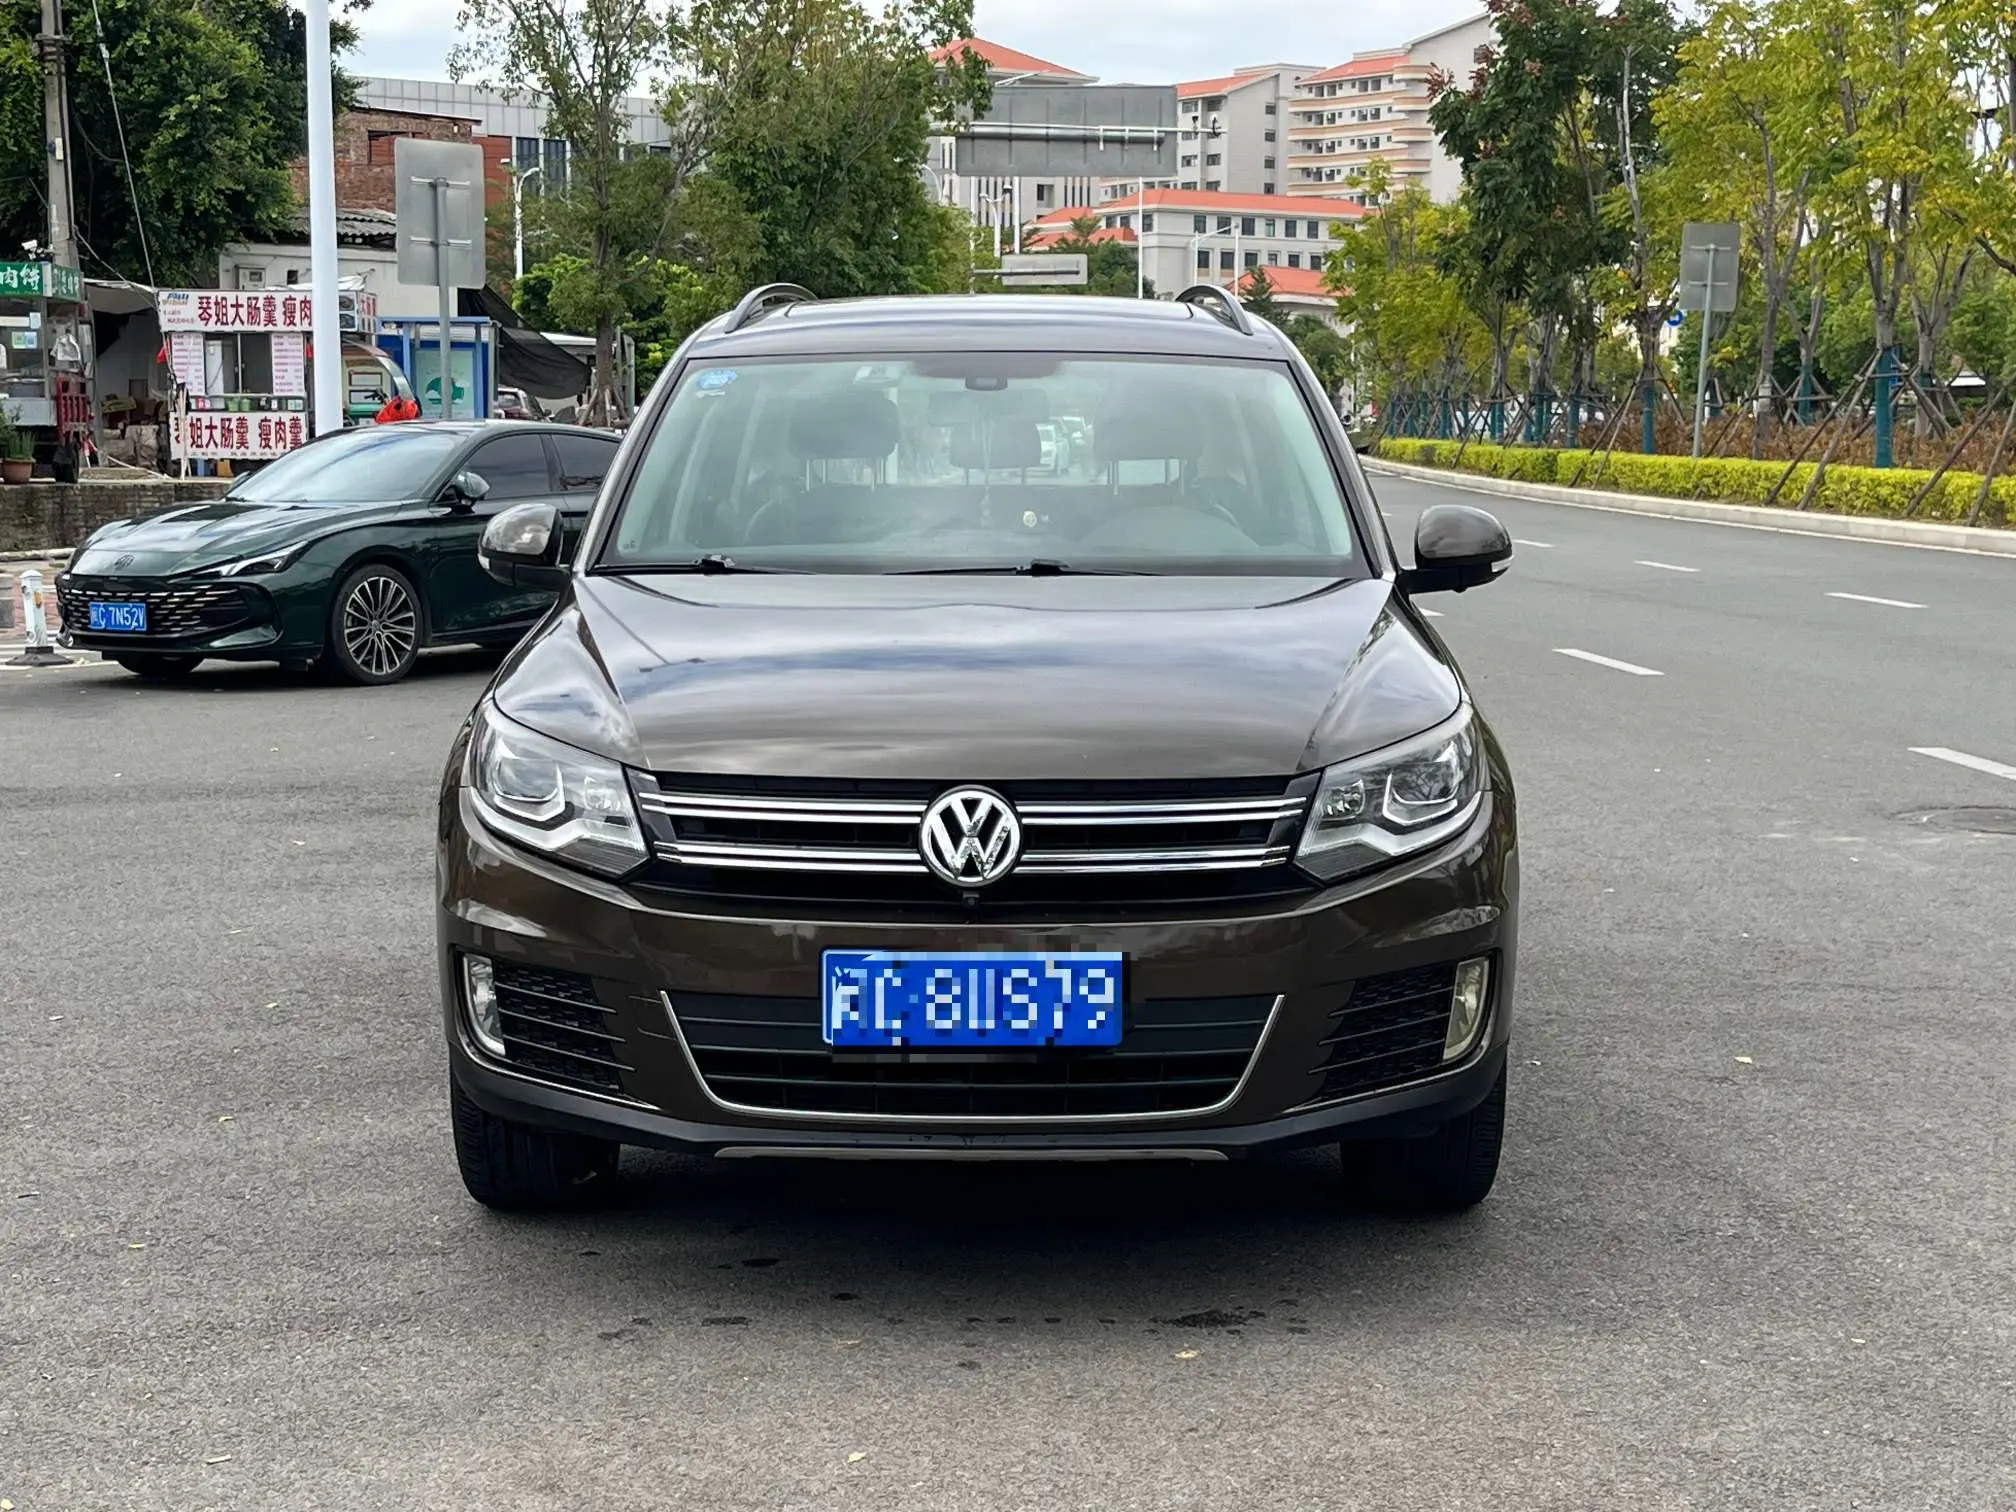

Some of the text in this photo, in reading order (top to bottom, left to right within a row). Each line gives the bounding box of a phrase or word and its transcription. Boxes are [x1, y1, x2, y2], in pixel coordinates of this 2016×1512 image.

[198, 295, 277, 327] 琴姐大肠羹
